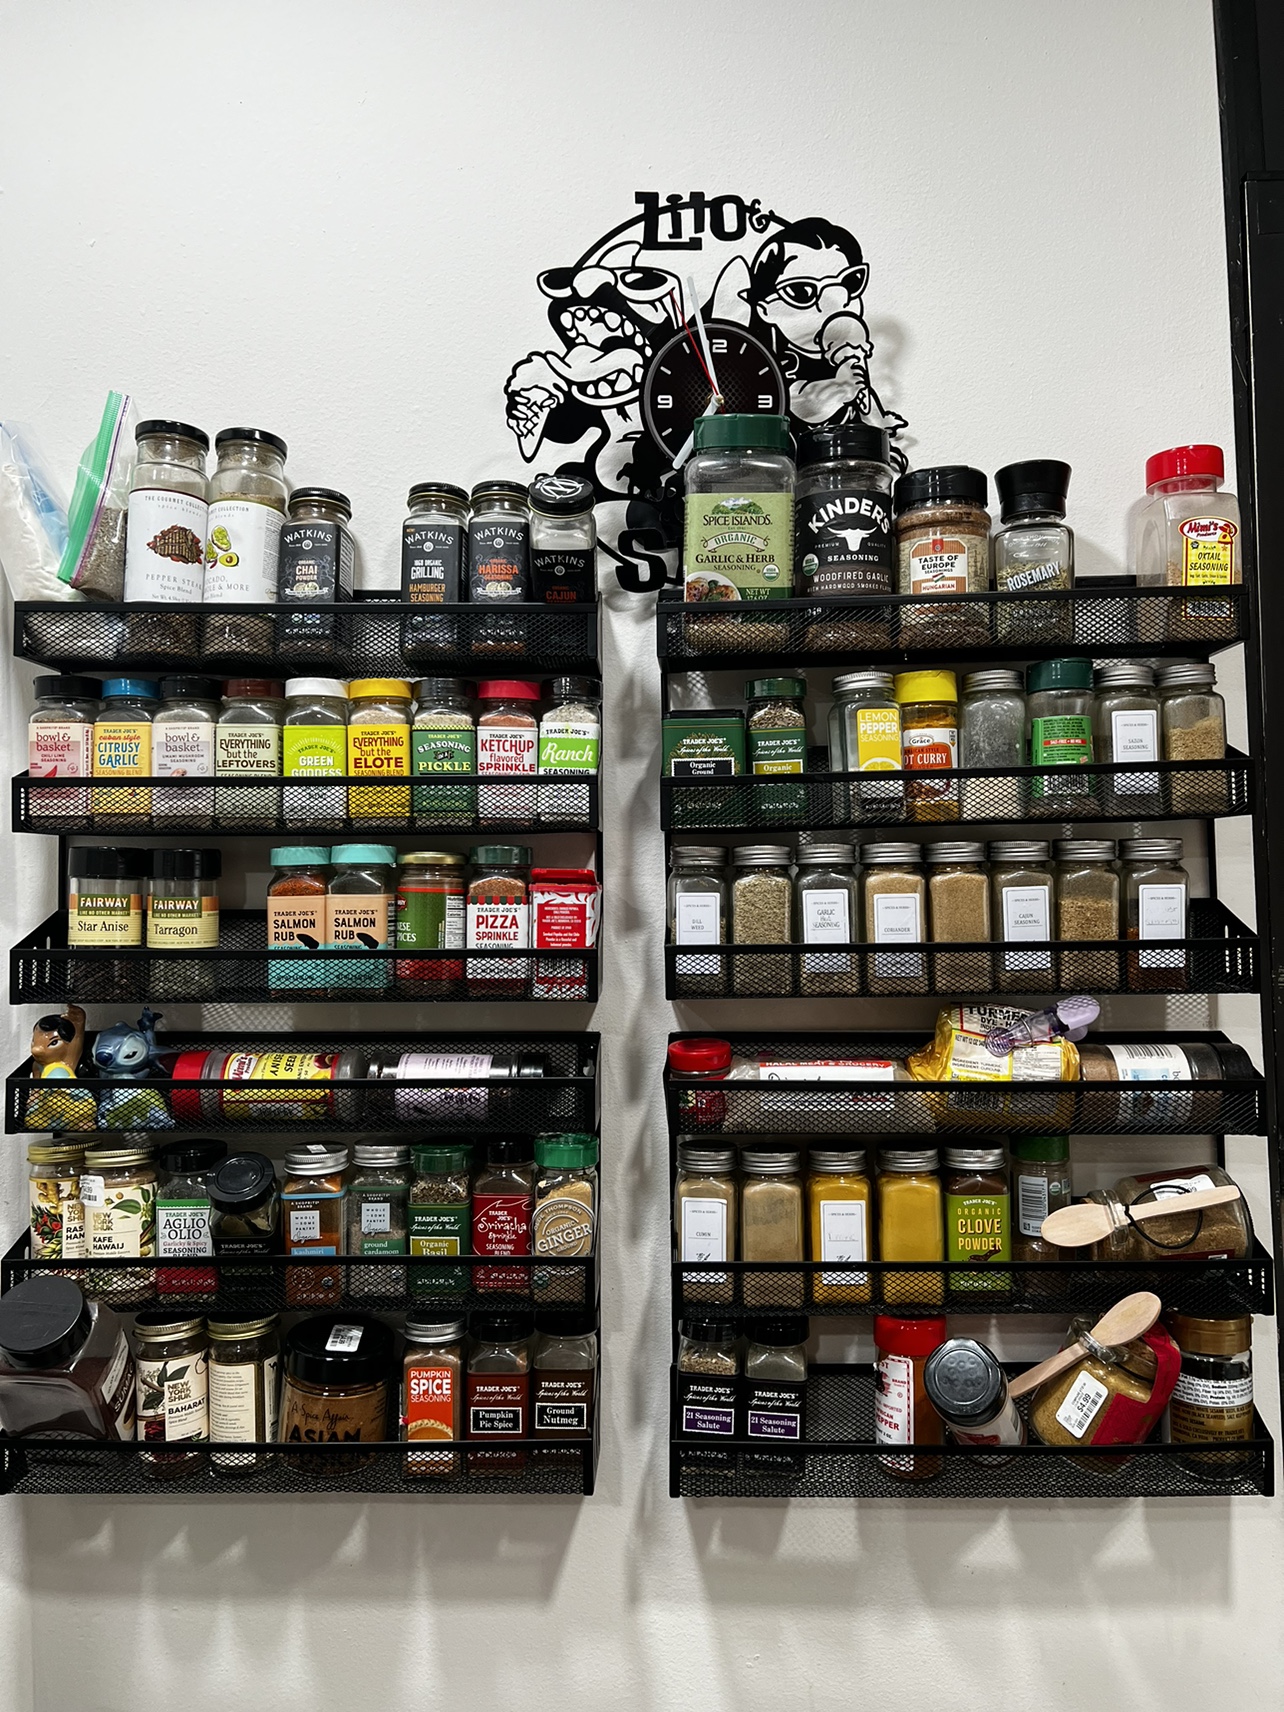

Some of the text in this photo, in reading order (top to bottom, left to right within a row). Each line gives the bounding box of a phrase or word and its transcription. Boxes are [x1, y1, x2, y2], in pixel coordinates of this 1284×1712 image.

[657, 395, 673, 408] 9
[758, 395, 772, 409] 3
[703, 514, 730, 526] SPICE
[808, 497, 891, 534] KINDER'S
[1187, 521, 1219, 533] Mimi's
[283, 530, 333, 543] WATKINS
[405, 529, 454, 545] WATKINS
[474, 527, 524, 541] WATKINS
[714, 534, 757, 545] ORGANIC
[534, 555, 585, 567] WATKINS
[695, 554, 775, 563] GARLIC & HERB
[918, 555, 944, 564] TASTE
[1198, 552, 1221, 560] OXTAIL
[295, 566, 318, 575] CHAI
[478, 565, 519, 574] HARISSA
[1189, 563, 1228, 571] SEASONING
[146, 573, 178, 583] PEPPER
[411, 566, 444, 580] GRILLING
[813, 572, 889, 583] WOODFIRED GARLIC
[1006, 561, 1061, 591] ROSEMARY
[226, 583, 250, 591] MORE
[409, 584, 446, 592] HAMBURGER
[923, 583, 955, 591] HUNGARIAN
[410, 593, 444, 602] SEASONING
[546, 591, 576, 600] CAJUN
[860, 712, 897, 721] LEMON
[860, 722, 898, 734] PEPPER
[36, 732, 70, 742] bowl &
[165, 733, 200, 742] bowl &
[860, 734, 899, 742] SEASONING
[36, 743, 71, 752] basket
[98, 742, 140, 753] CITRUSY
[165, 743, 200, 752] basket
[220, 739, 271, 752] EVERYTHING
[353, 736, 404, 750] EVERYTHING
[417, 740, 471, 754] SEASONING
[480, 739, 534, 755] KETCHUP
[227, 750, 257, 758] but the
[360, 747, 391, 756] but the
[541, 743, 593, 764] Ranch
[99, 754, 138, 768] GARLIC
[299, 756, 333, 766] GREEN
[354, 757, 404, 768] ELOTE
[490, 753, 524, 763] flavored
[917, 753, 947, 764] CURRY
[217, 760, 275, 768] LEFTOVERS
[418, 762, 471, 771] PICKLE
[479, 763, 536, 772] SPRINKLE
[690, 761, 716, 769] Organic
[764, 764, 792, 772] Organic
[291, 768, 342, 776] GODDESS
[80, 897, 128, 907] FAIRWAY
[154, 900, 199, 910] FAIRWAY
[78, 921, 129, 932] Star Anise
[273, 919, 316, 929] SALMON
[334, 918, 376, 928] SALMON
[476, 915, 519, 929] PIZZA
[154, 924, 198, 937] Tarragon
[334, 930, 355, 940] RUB
[274, 932, 295, 941] RUB
[476, 932, 518, 940] SPRINKLE
[981, 1017, 996, 1025] DYE
[163, 1218, 206, 1229] AGLIO
[478, 1217, 527, 1234] Sriracha
[546, 1220, 576, 1236] ORGANIC
[958, 1219, 1002, 1234] CLOVE
[168, 1229, 202, 1240] OLIO
[537, 1223, 593, 1253] GINGER
[420, 1240, 449, 1248] Organic
[486, 1243, 514, 1251] SEASONING
[959, 1238, 1002, 1250] POWDER
[410, 1371, 451, 1379] PUMPKIN
[115, 1361, 133, 1412] SUMAC
[167, 1380, 189, 1390] NEW
[410, 1379, 451, 1394] SPICE
[690, 1385, 713, 1393] TRADER
[168, 1387, 191, 1396] YORK
[755, 1391, 778, 1399] TRADER
[168, 1393, 191, 1403] SHUK
[411, 1394, 451, 1402] SEASONING
[1077, 1393, 1091, 1413] $4.99
[168, 1397, 205, 1415] BAHARAT
[547, 1407, 574, 1415] Ground
[479, 1411, 513, 1419] Pumpkin
[543, 1415, 579, 1425] Nutmeg
[695, 1412, 731, 1422] Seasoning
[697, 1421, 720, 1429] Salute
[751, 1416, 796, 1427] 21 Seasoning
[289, 1424, 362, 1442] ASIAN
[762, 1425, 785, 1434] Salute
